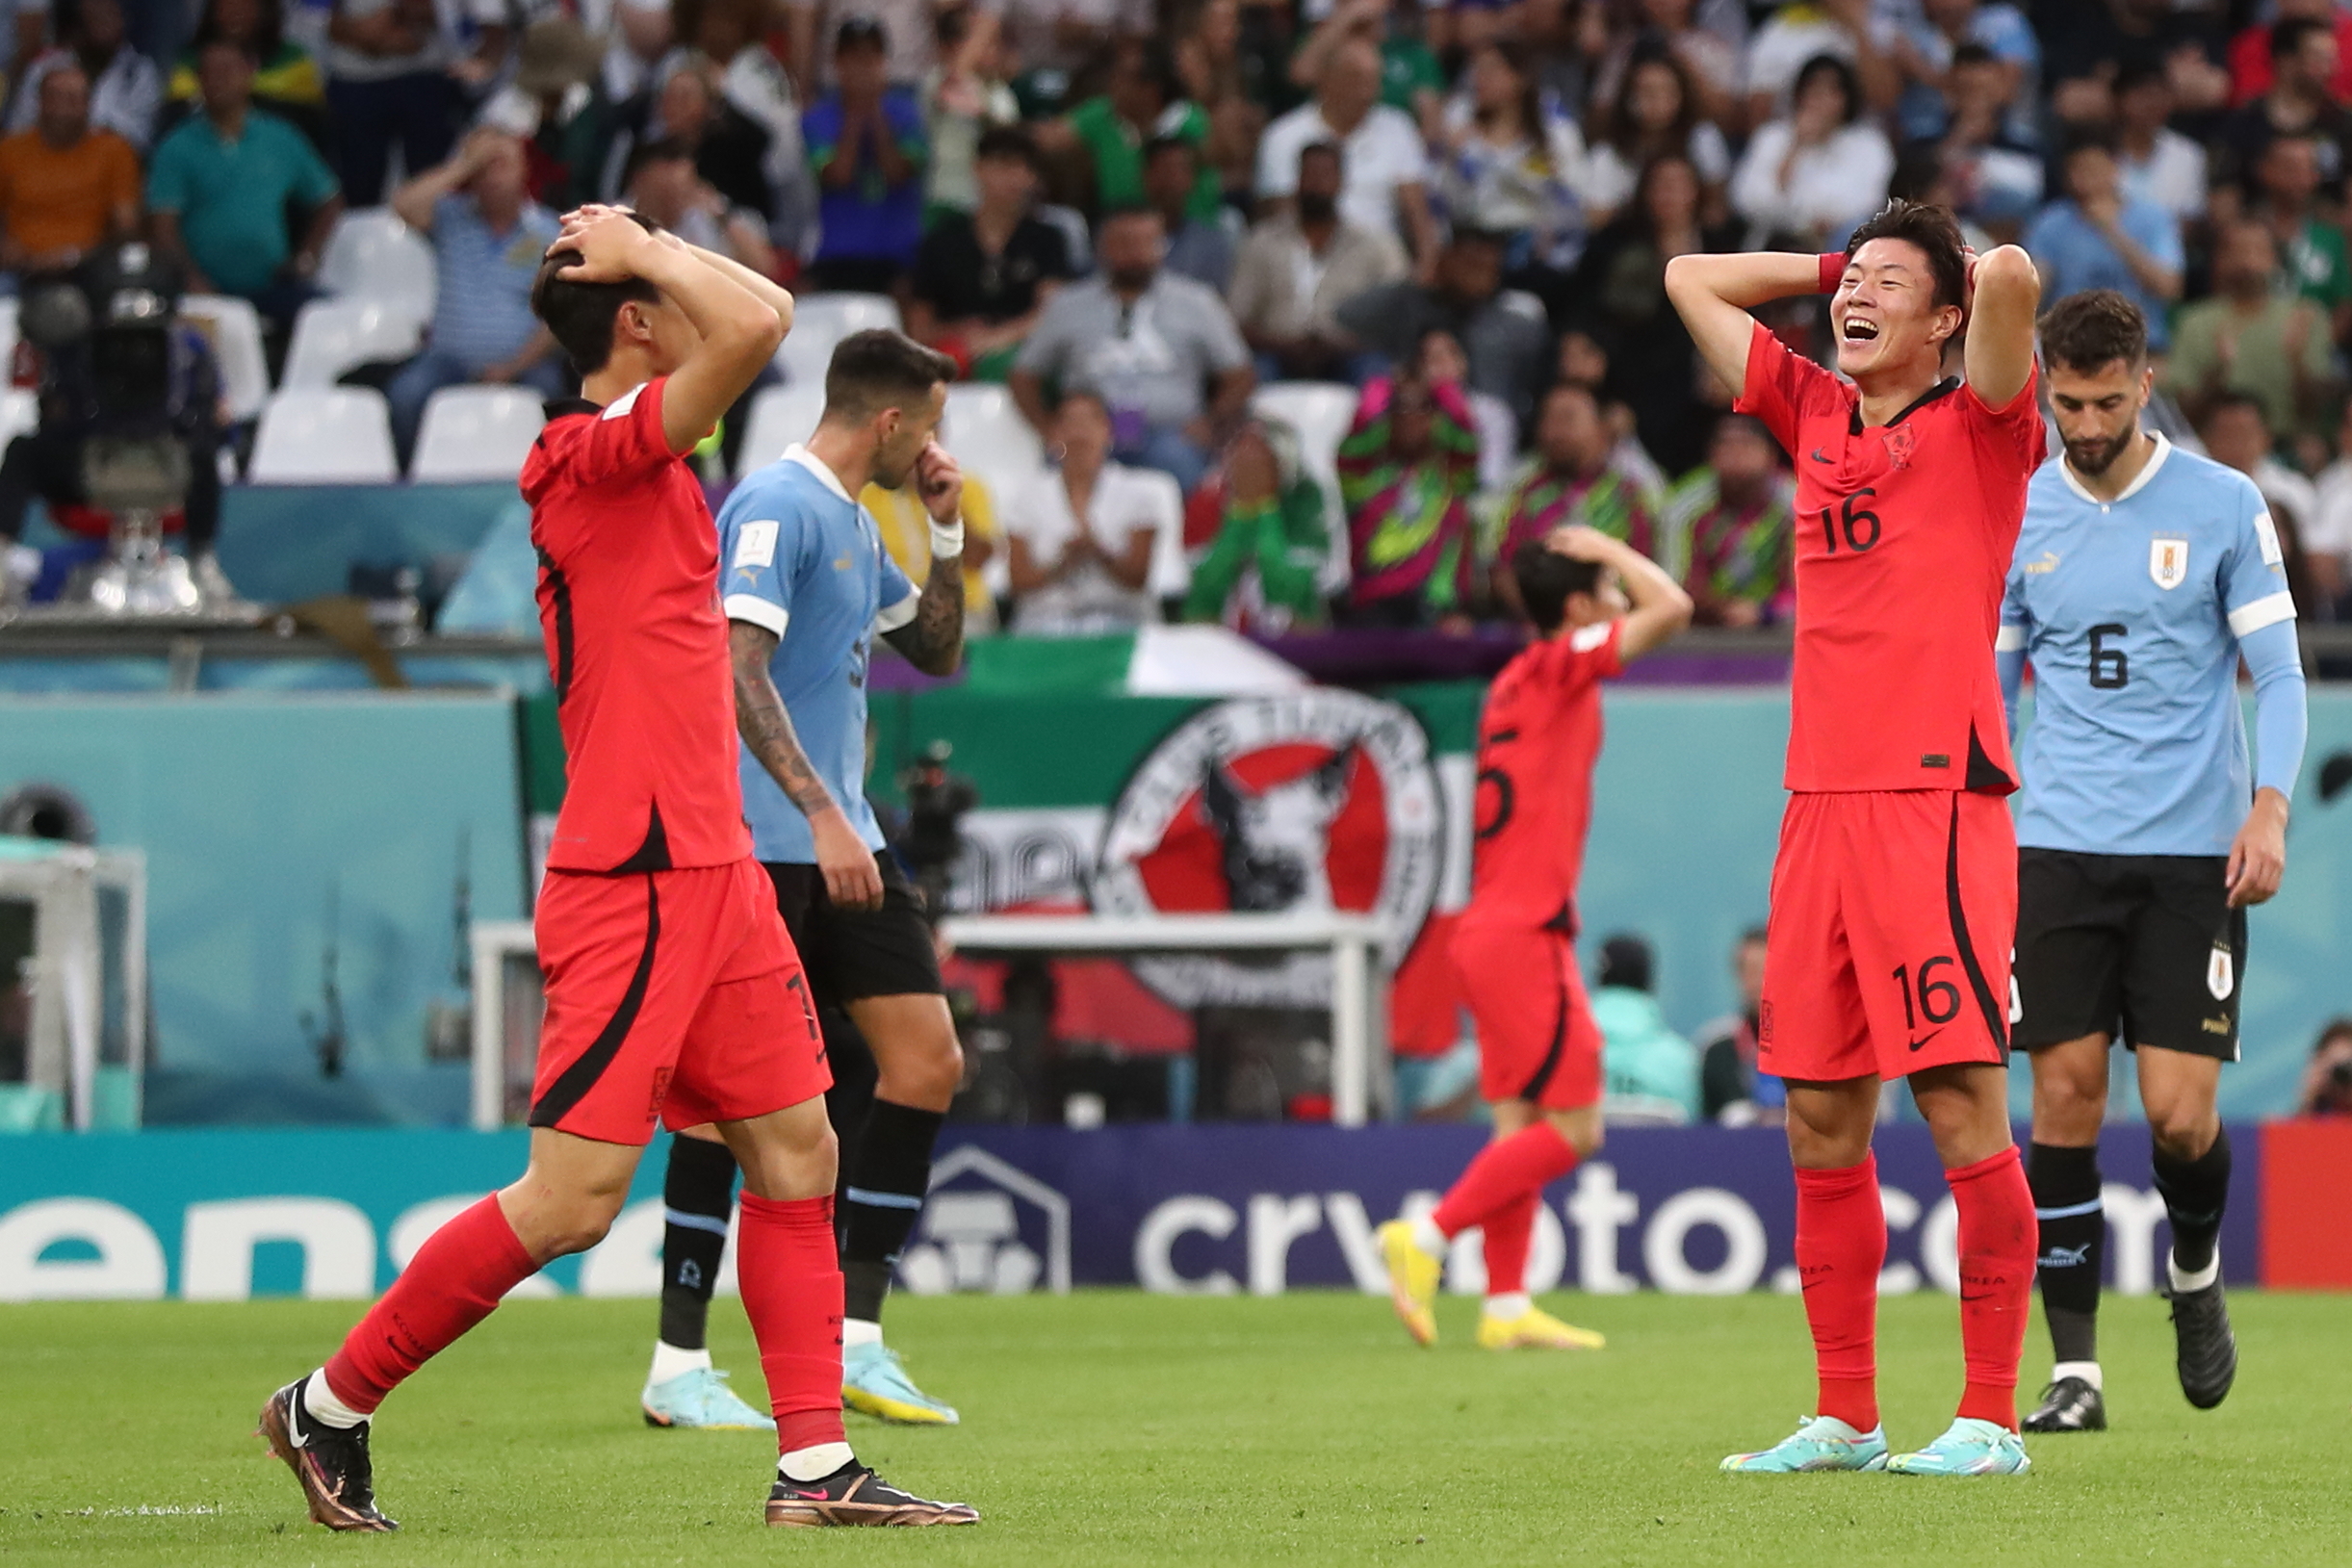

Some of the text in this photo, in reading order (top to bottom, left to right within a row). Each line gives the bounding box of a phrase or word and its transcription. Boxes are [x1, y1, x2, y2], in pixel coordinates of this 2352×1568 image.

[1822, 487, 1881, 554] 16
[2090, 624, 2128, 690] 6
[1892, 956, 1960, 1030] 16
[1134, 1162, 2172, 1296] cryto.m
